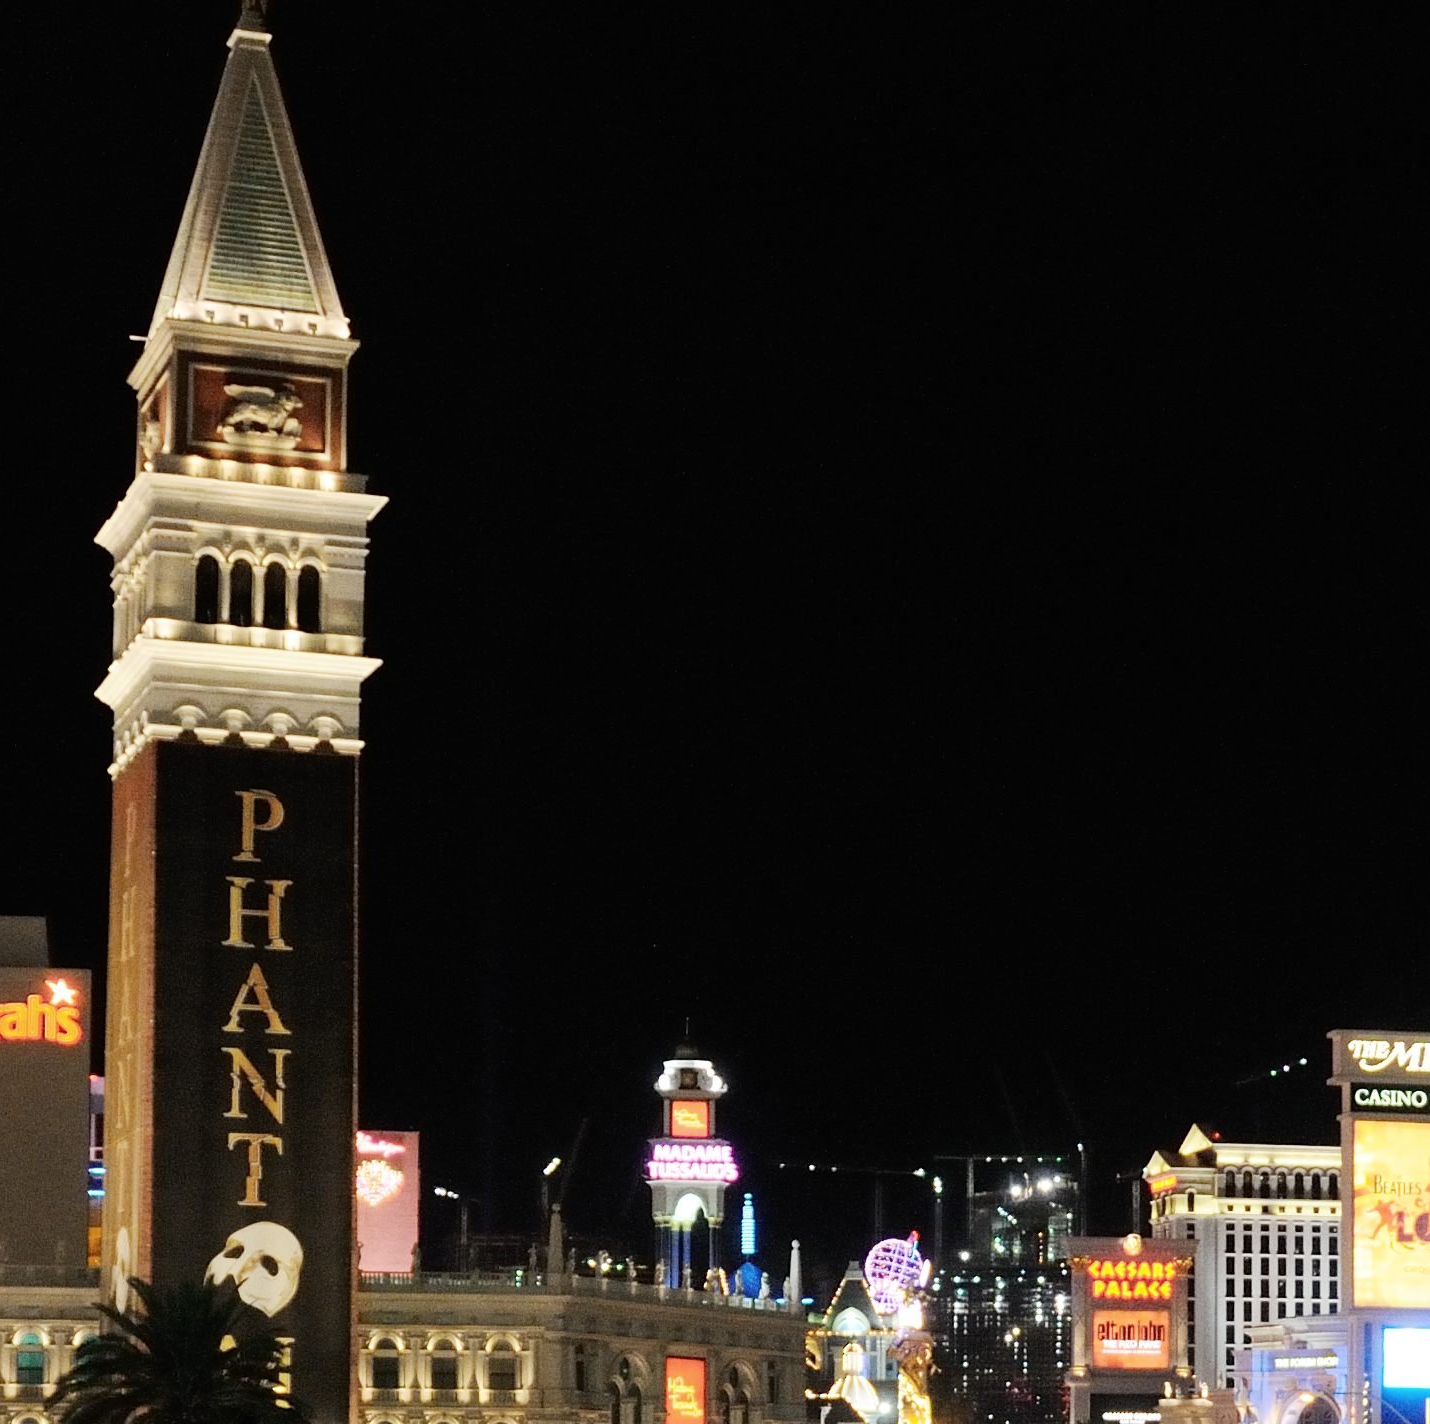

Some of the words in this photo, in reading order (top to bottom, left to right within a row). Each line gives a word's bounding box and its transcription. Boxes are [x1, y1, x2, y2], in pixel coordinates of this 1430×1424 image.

[1347, 1039, 1392, 1060] THE
[1354, 1088, 1428, 1108] CASINO
[653, 1144, 734, 1162] MADAME
[1088, 1260, 1177, 1280] CAESARS
[1092, 1280, 1173, 1300] PALACE
[1098, 1320, 1135, 1341] elton
[1137, 1320, 1166, 1342] john
